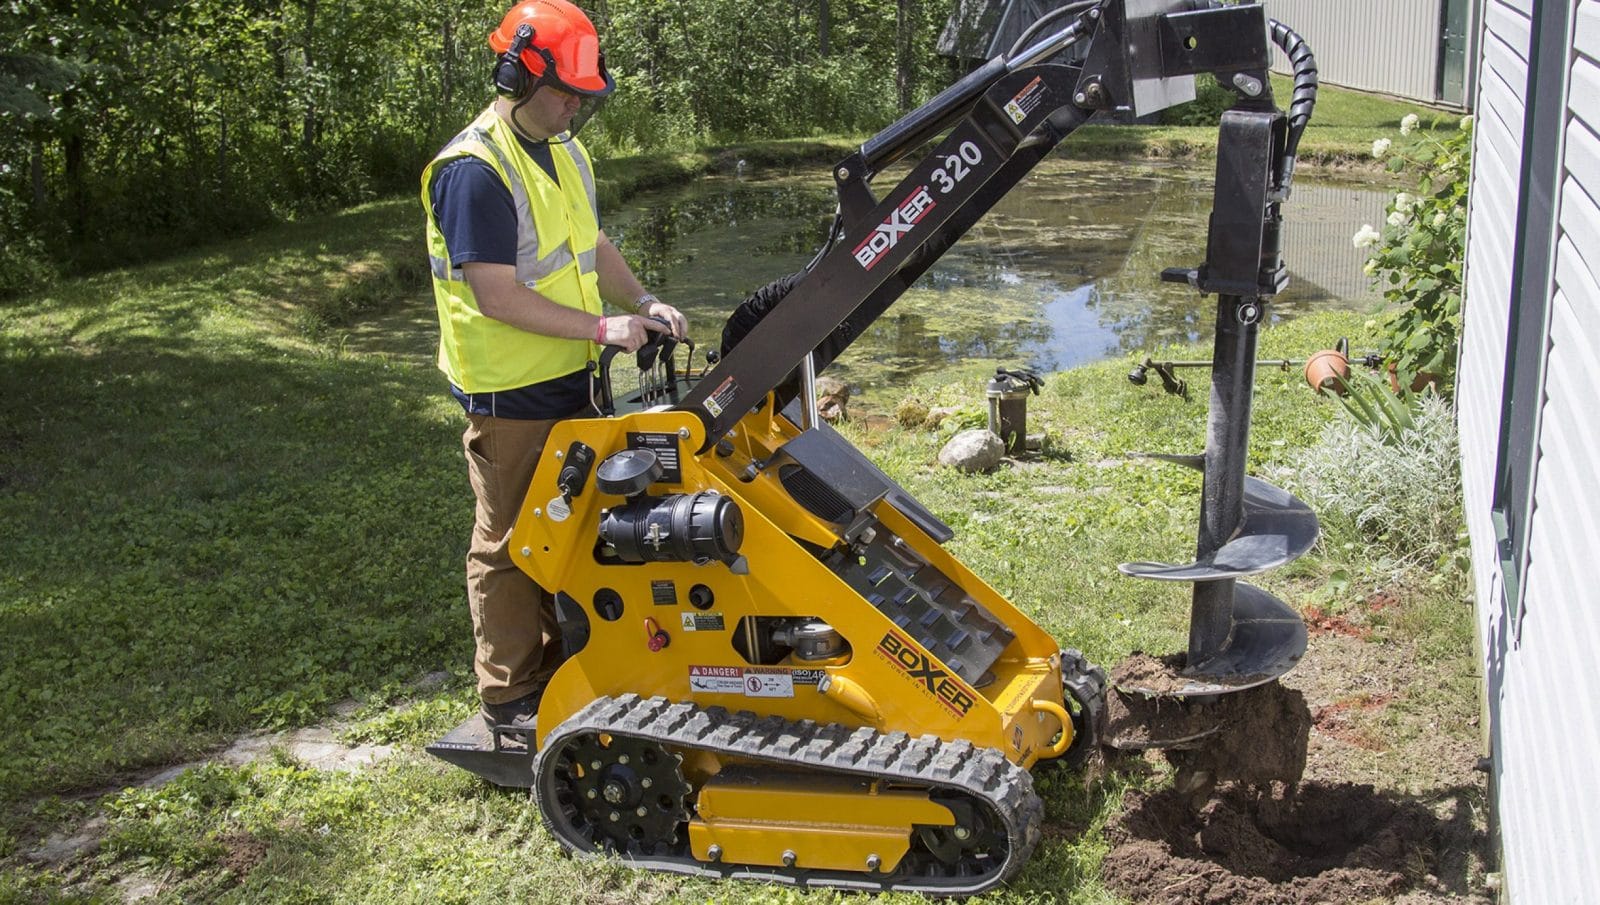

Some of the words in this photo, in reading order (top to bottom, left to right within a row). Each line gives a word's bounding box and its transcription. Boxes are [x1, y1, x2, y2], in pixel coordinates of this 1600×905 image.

[855, 190, 934, 268] BOXER
[931, 141, 982, 194] 320
[702, 667, 739, 677] DANGER!
[753, 667, 789, 675] WARNING
[879, 633, 974, 714] BOXER
